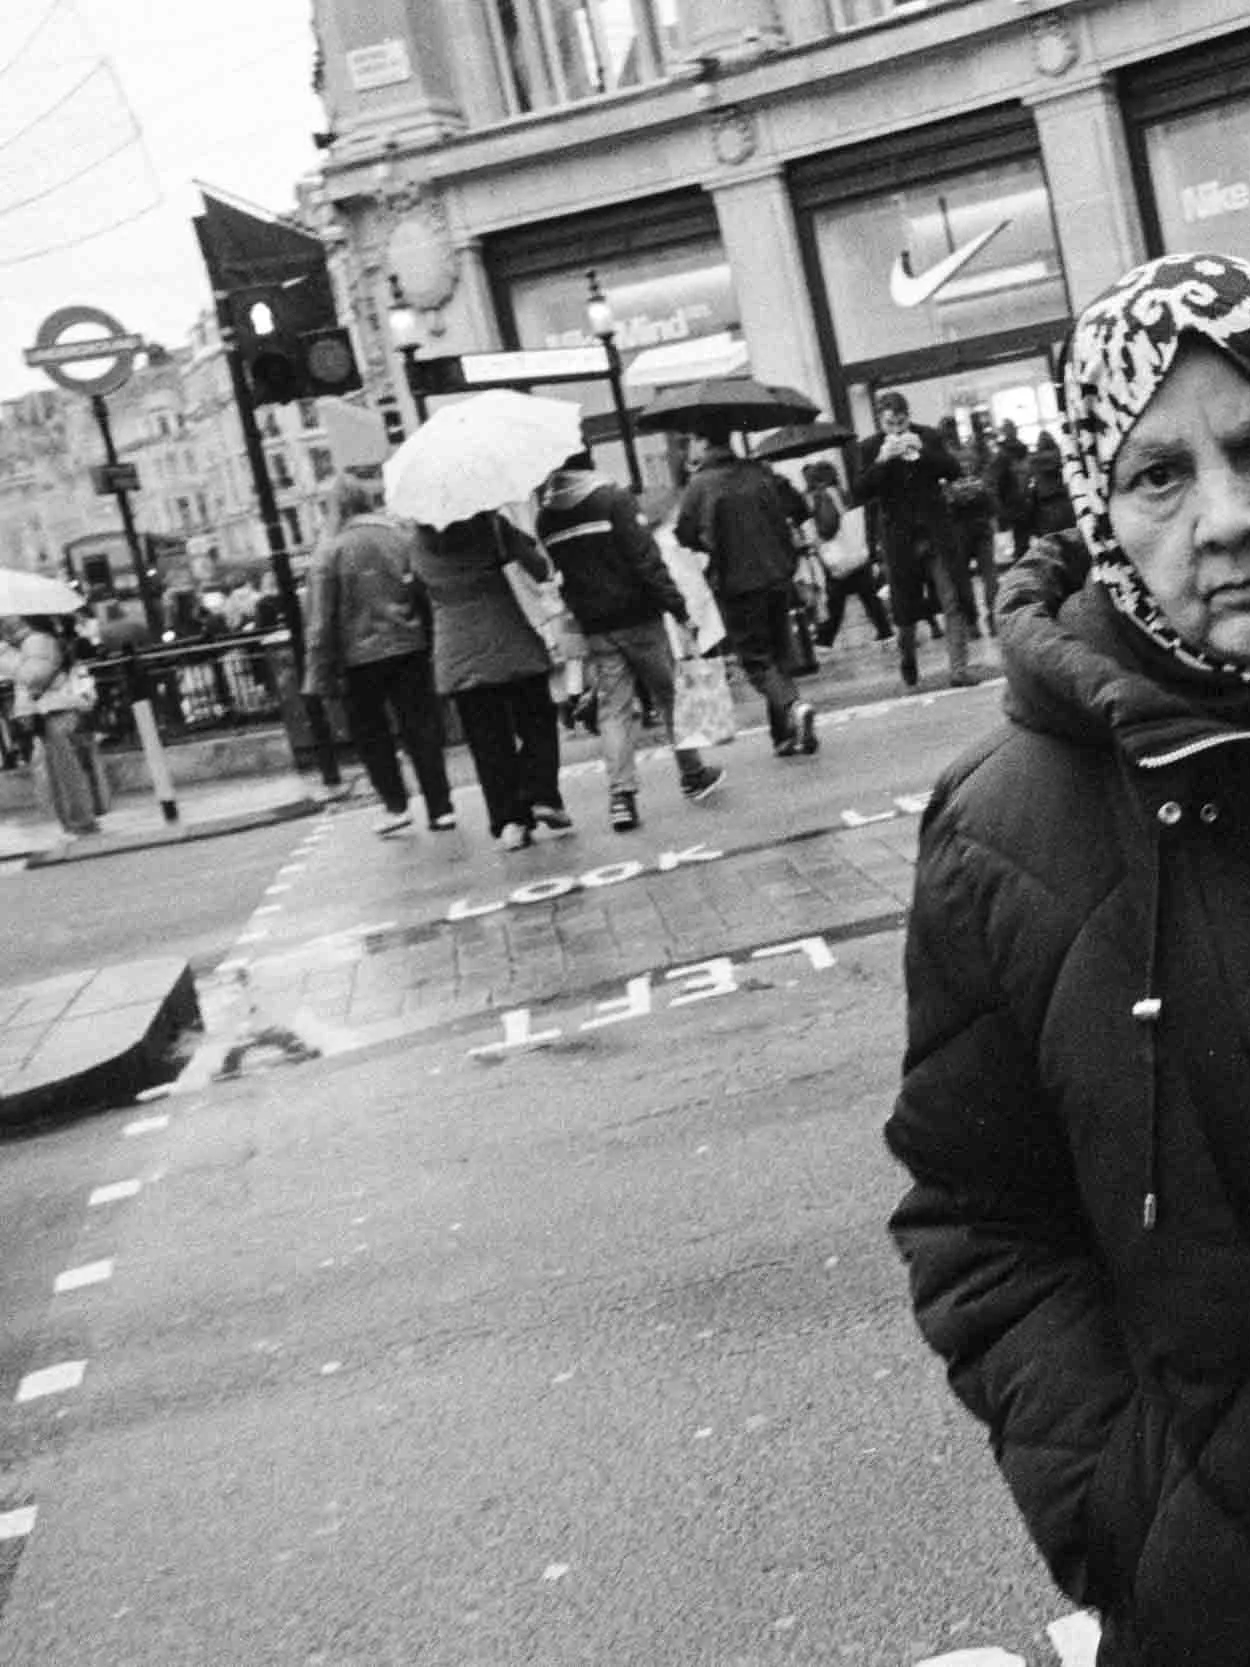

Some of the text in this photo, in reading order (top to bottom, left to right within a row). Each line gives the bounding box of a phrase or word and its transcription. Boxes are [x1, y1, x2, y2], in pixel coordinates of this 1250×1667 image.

[1182, 181, 1249, 223] Nike
[447, 791, 935, 920] LOOK LE
[466, 936, 836, 1057] LEFT
